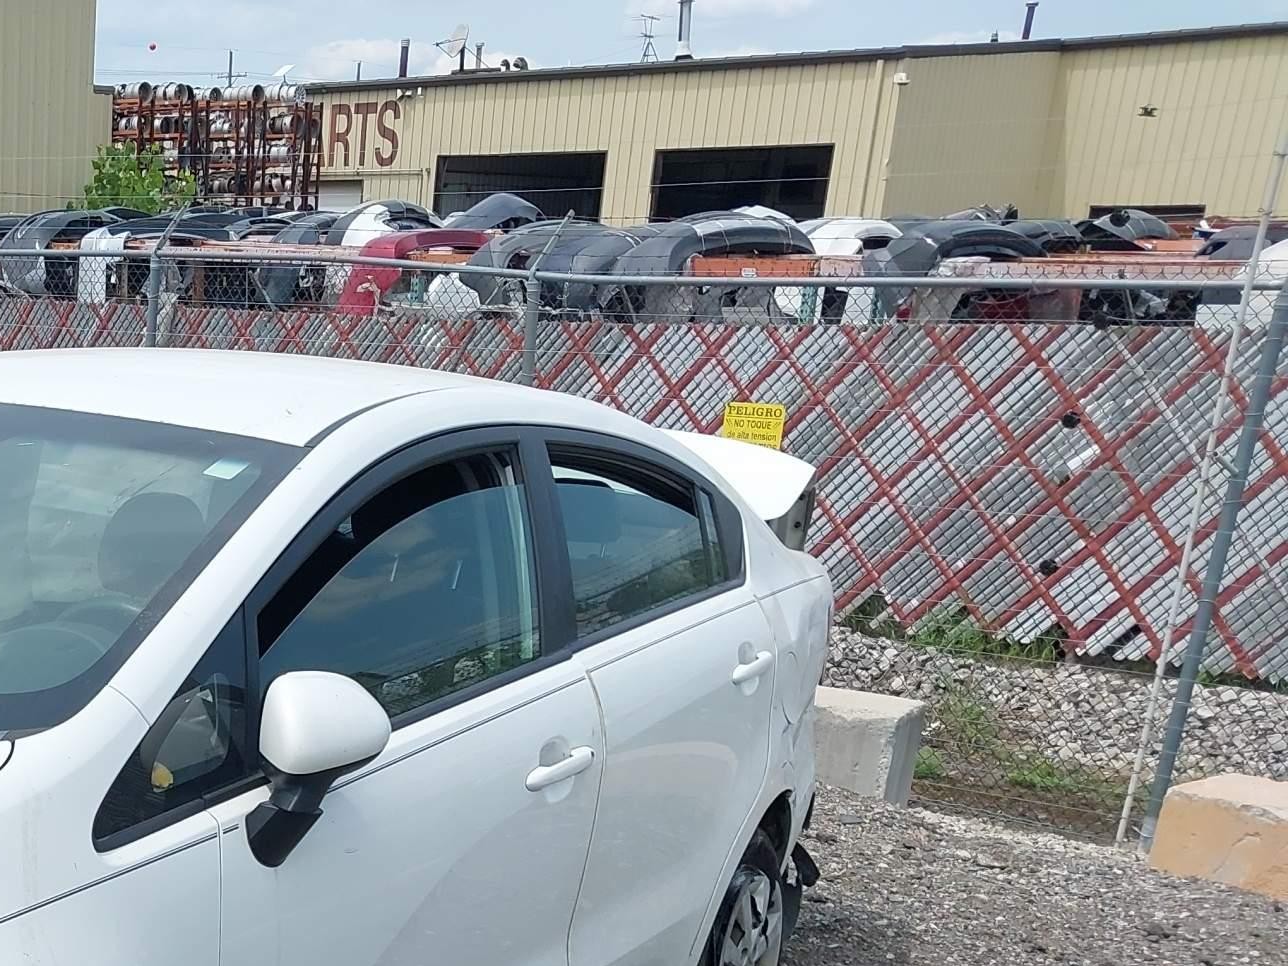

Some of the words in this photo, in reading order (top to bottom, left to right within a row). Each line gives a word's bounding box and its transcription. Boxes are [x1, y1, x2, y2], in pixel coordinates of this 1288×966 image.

[727, 404, 783, 418] PELIGRO
[734, 418, 745, 428] NO
[747, 419, 772, 430] TOQUE
